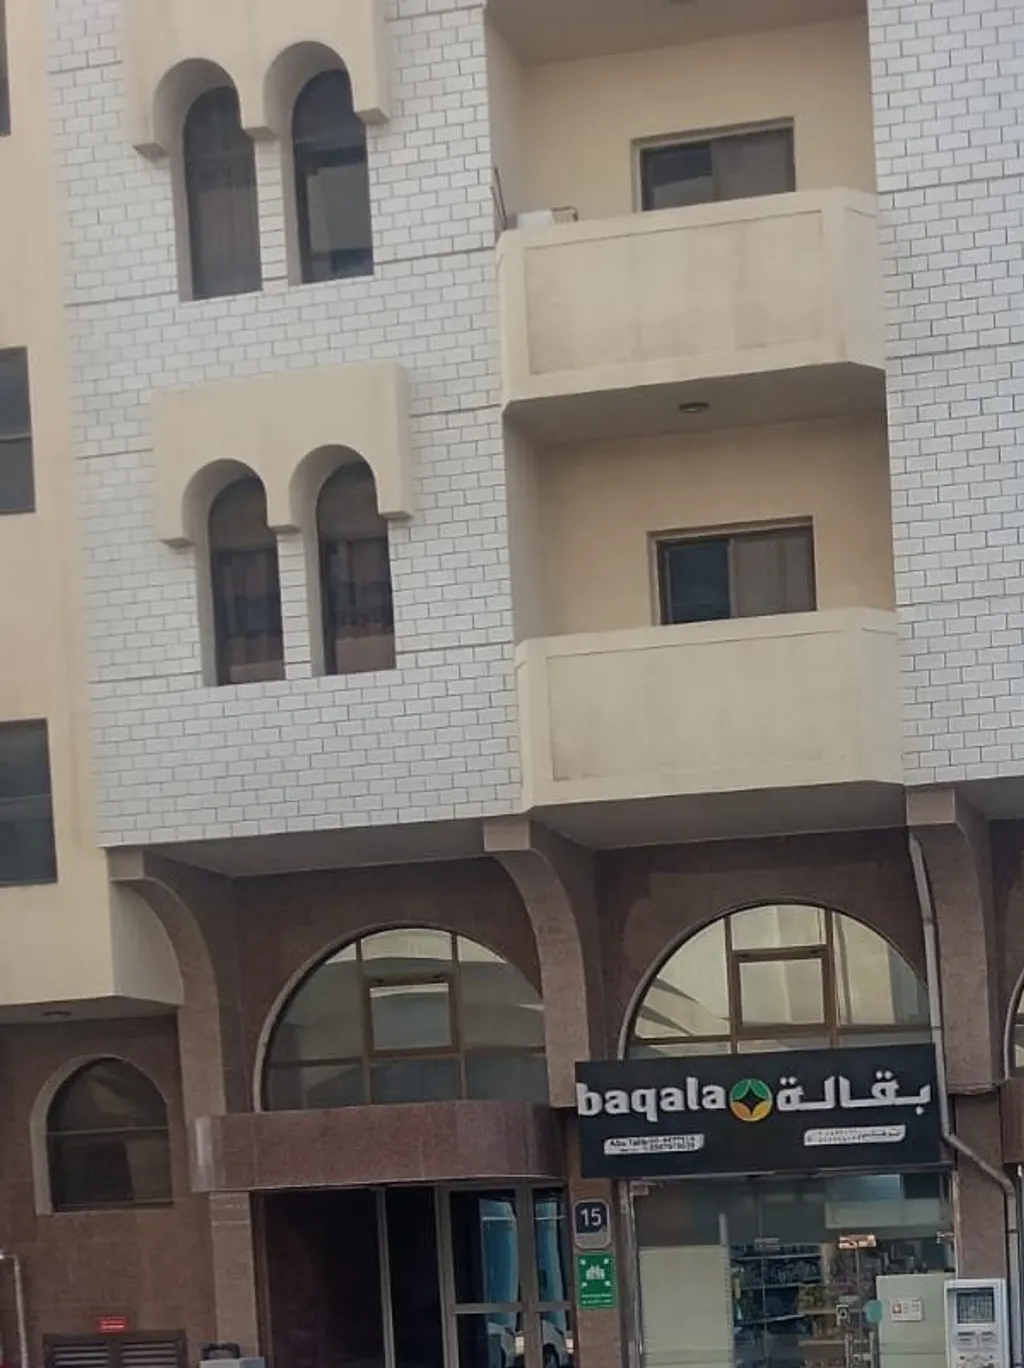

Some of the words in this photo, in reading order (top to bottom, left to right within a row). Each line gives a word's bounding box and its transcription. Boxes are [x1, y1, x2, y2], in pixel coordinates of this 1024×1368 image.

[577, 1076, 727, 1123] baqala
[777, 1069, 932, 1116] بقالة
[580, 1207, 602, 1227] 15
